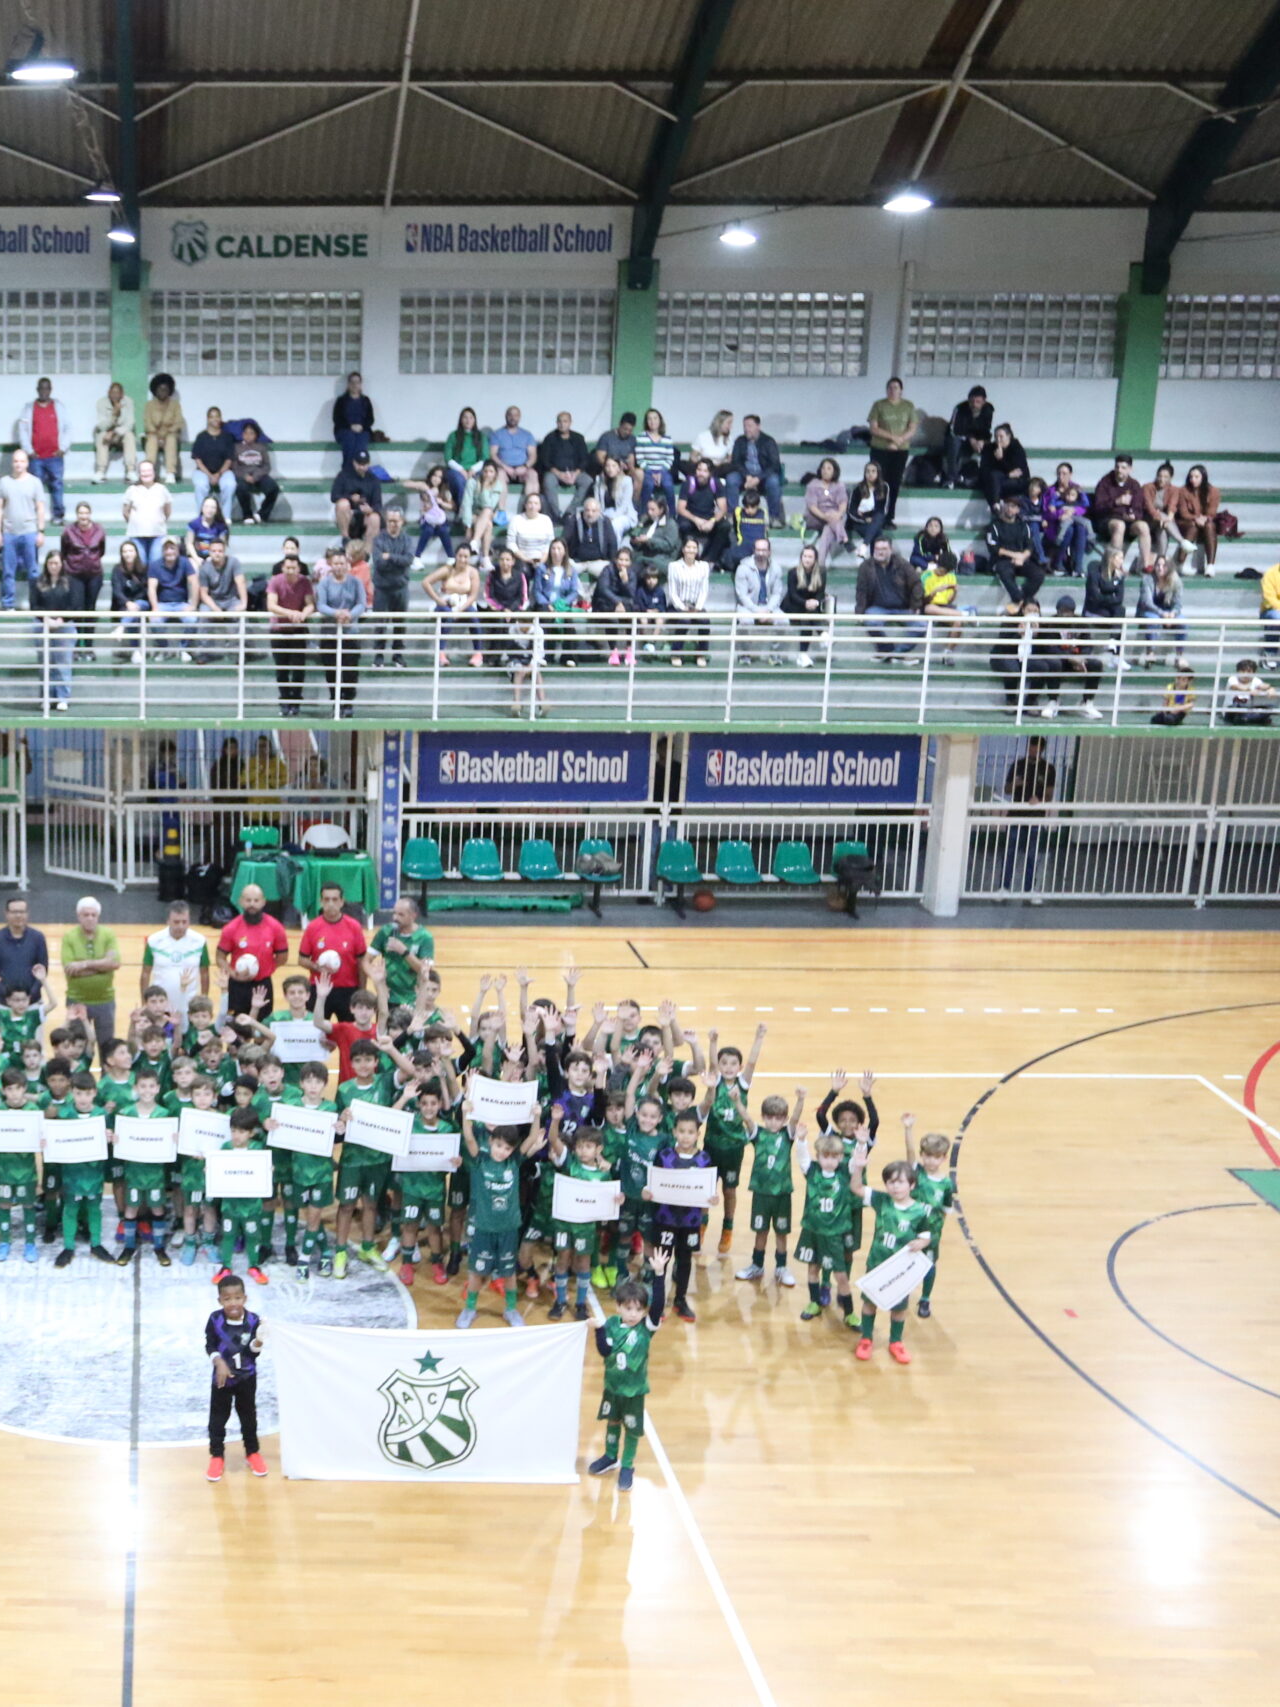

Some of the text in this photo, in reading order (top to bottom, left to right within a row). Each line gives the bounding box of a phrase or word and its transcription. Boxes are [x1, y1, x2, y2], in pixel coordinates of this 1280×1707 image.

[32, 224, 90, 253] School
[421, 223, 613, 252] NBA Basketball School
[216, 234, 368, 258] CALDENSE
[457, 750, 629, 783] Basketball School
[723, 750, 900, 787] Basketball School
[562, 1119, 578, 1136] 12
[767, 1155, 776, 1169] 9
[345, 1187, 358, 1200] 10
[404, 1205, 419, 1218] 10
[819, 1198, 834, 1212] 10
[755, 1215, 763, 1229] 9
[556, 1232, 567, 1247] 10
[661, 1231, 673, 1246] 12
[883, 1232, 896, 1249] 10
[799, 1247, 813, 1262] 10
[232, 1352, 241, 1370] 1
[616, 1352, 627, 1370] 9
[402, 1391, 438, 1405] A C
[602, 1401, 611, 1415] 9
[398, 1413, 408, 1428] A
